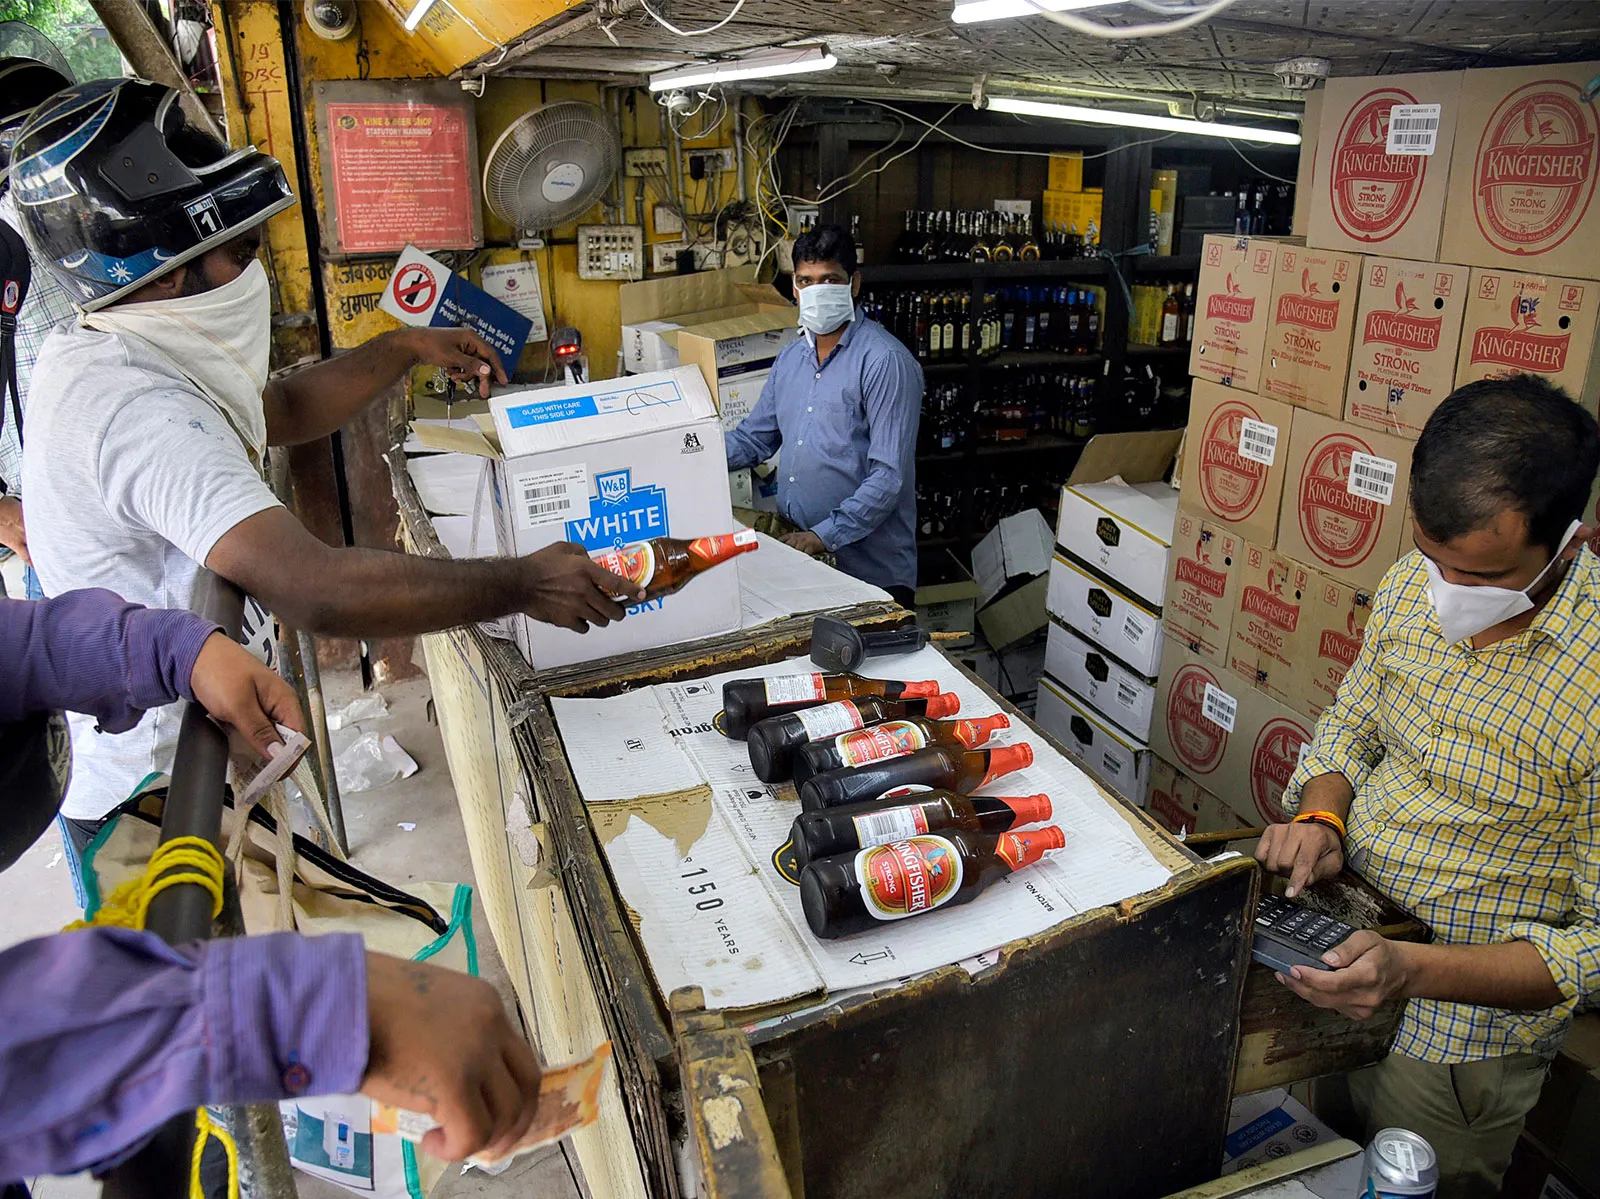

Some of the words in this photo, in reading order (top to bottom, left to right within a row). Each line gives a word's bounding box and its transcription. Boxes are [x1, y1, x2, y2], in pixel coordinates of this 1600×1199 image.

[250, 43, 269, 60] 19
[1342, 150, 1415, 176] KINGFISHER
[1487, 150, 1584, 180] KINGFISHER
[1358, 192, 1386, 203] STRONG
[1509, 197, 1546, 208] STRONG
[201, 211, 217, 232] 1
[1210, 297, 1252, 319] KINGFISHER
[1280, 298, 1334, 328] KINGFISHER
[478, 318, 489, 330] Not
[488, 324, 496, 334] be
[495, 329, 510, 342] Sold
[508, 337, 516, 346] to
[1213, 326, 1241, 340] STRONG
[1284, 332, 1321, 352] STRONG
[1369, 315, 1436, 348] KINGFISHER
[494, 340, 503, 348] of
[501, 343, 513, 355] Age
[718, 340, 745, 351] SPECIAL
[1477, 331, 1561, 368] KINGFISHER
[1373, 352, 1420, 374] STRONG
[1358, 370, 1369, 380] The
[1369, 373, 1384, 385] King
[1392, 380, 1411, 390] Good
[1411, 383, 1432, 395] Times
[522, 407, 545, 416] GLASS
[545, 404, 562, 412] WITH
[563, 401, 581, 410] CARE
[532, 414, 550, 422] THIS
[550, 411, 565, 419] SIDE
[565, 409, 576, 417] UP
[722, 407, 750, 418] SPECIAL
[725, 399, 747, 410] PARTY
[1207, 442, 1260, 478] KINGFISHER
[601, 479, 626, 494] W&B
[1307, 480, 1372, 518] KINGFISHER
[1097, 528, 1118, 545] SPECIAL
[1323, 520, 1349, 535] STRONG
[1178, 560, 1223, 594] KINGFISHER
[1182, 589, 1212, 613] STRONG
[1245, 589, 1295, 630] KINGFISHER
[1248, 621, 1283, 648] STRONG
[881, 861, 897, 894] STRONG
[890, 839, 926, 913] KINGFISHER
[681, 867, 725, 912] 150
[1034, 893, 1055, 912] BATCH
[714, 917, 740, 955] YEARS
